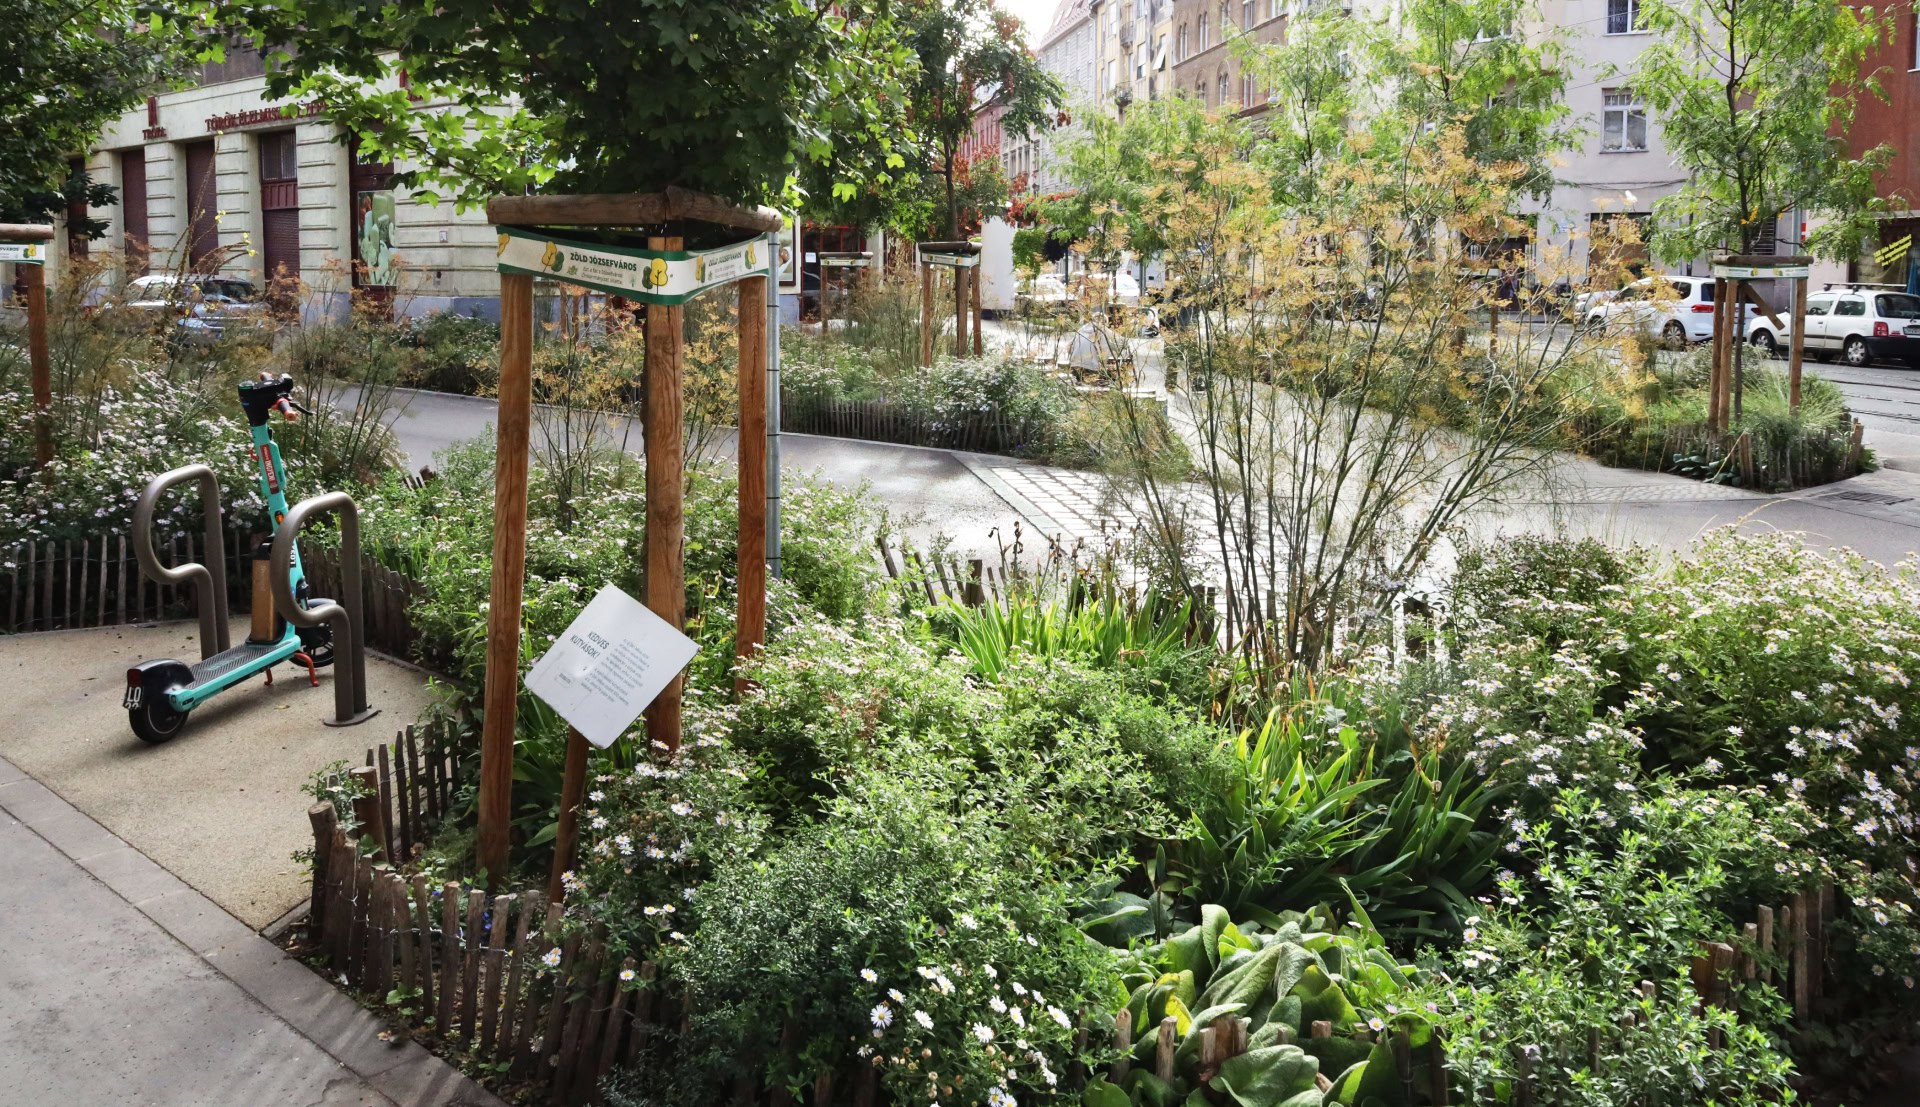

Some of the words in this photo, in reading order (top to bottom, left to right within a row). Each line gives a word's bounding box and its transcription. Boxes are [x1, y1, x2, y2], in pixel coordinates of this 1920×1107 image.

[570, 251, 588, 262] ZÖLD
[589, 255, 637, 272] JÓZSEFVÁROS
[570, 635, 601, 660] KUTYÁSOK!
[588, 631, 610, 650] KEDVES
